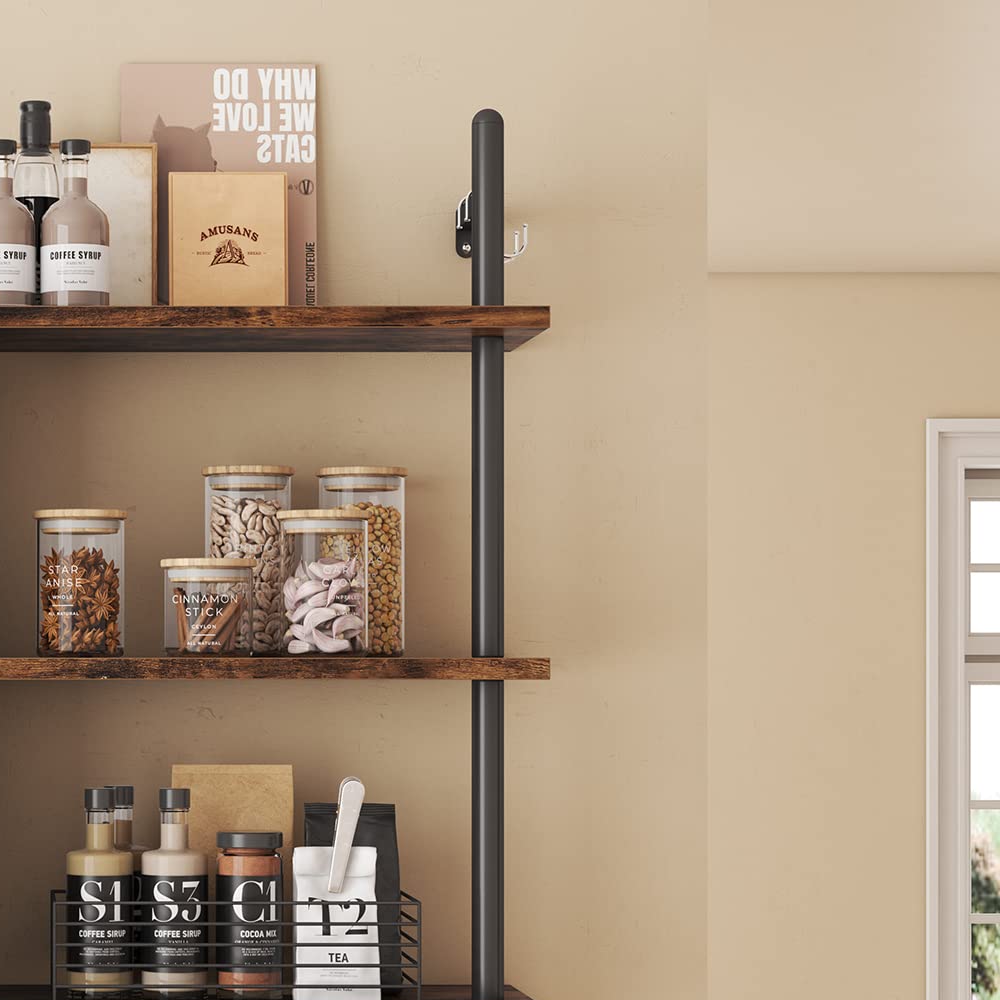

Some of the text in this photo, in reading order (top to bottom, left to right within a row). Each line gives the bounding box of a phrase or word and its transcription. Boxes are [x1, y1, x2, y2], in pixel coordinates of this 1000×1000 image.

[200, 225, 259, 242] AMUSANS
[3, 250, 27, 260] SYRUP
[50, 250, 102, 260] COFFEE SYRUP
[48, 565, 79, 574] STAR
[45, 578, 82, 587] ANISE
[172, 594, 238, 604] CINNAMON
[185, 607, 223, 617] STICK
[78, 880, 125, 923] S1
[151, 880, 202, 923] S3
[232, 880, 279, 923] C1
[308, 897, 369, 936] T2
[79, 930, 126, 938] COFFEE SIRUP
[154, 930, 202, 938] COFFEE SIRUP
[240, 930, 277, 938] COCOA MIX
[328, 953, 349, 962] TEA
